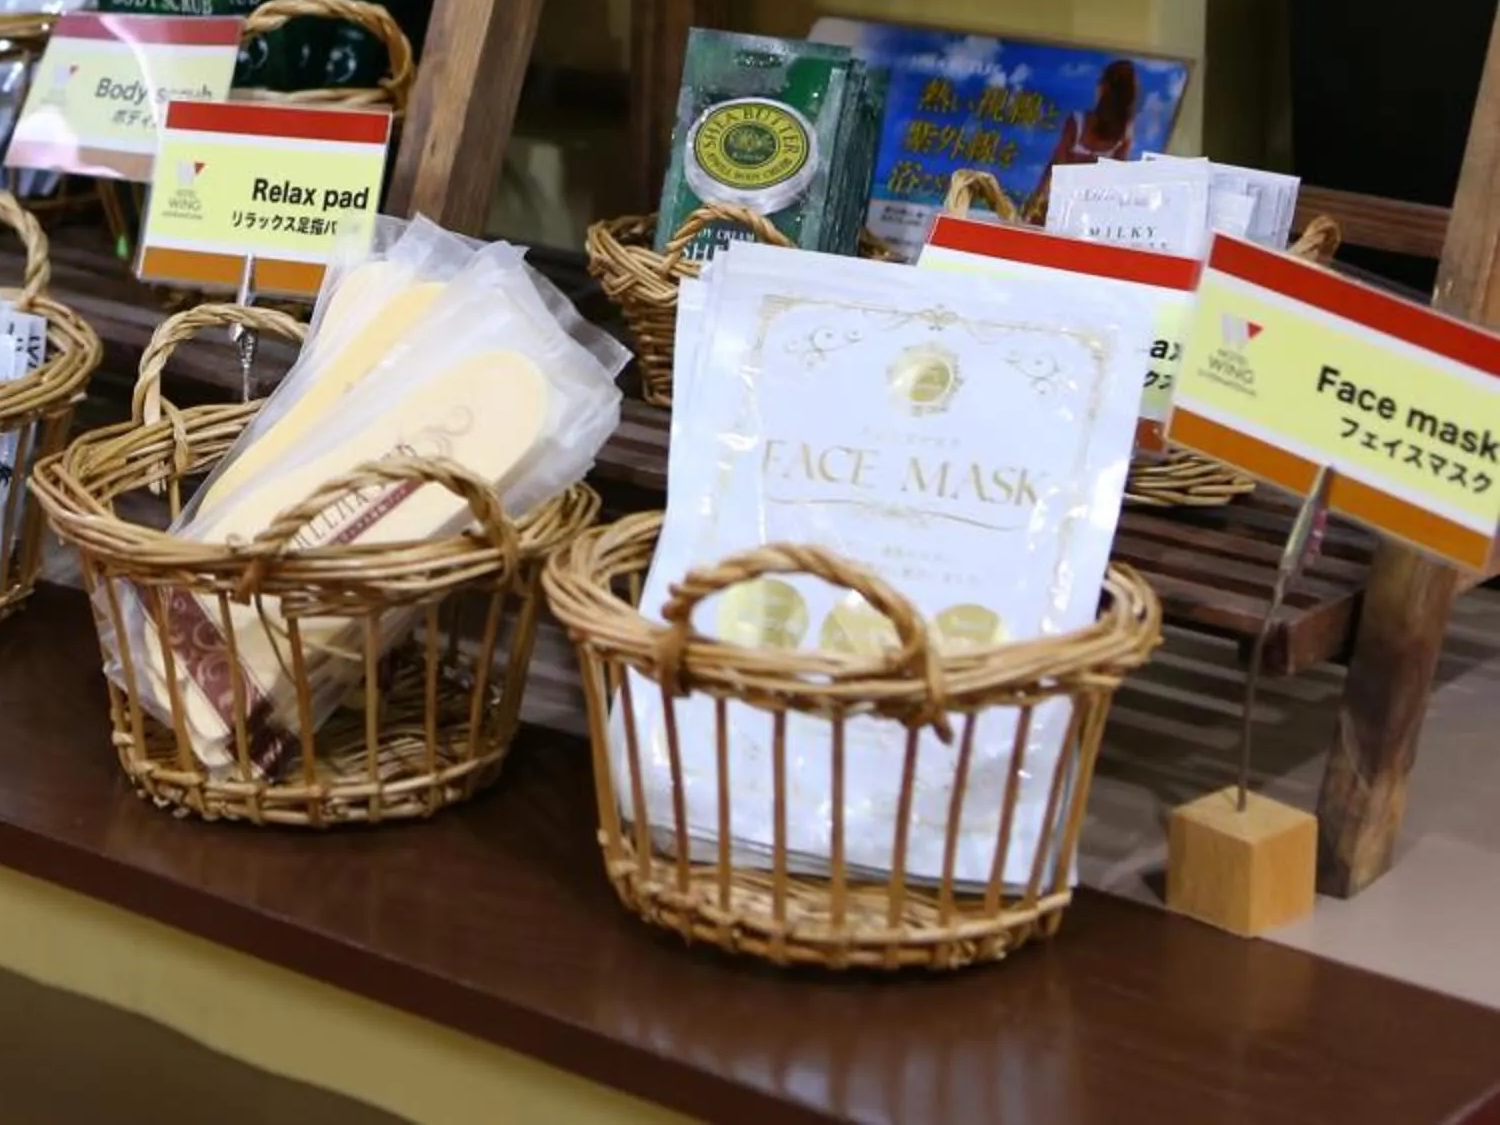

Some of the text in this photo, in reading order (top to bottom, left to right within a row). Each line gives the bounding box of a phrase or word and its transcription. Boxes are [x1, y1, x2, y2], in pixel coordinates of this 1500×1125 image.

[94, 77, 150, 106] Body
[251, 177, 370, 213] Relax pad
[1089, 223, 1158, 240] MILKY
[1208, 355, 1257, 385] WING
[1316, 363, 1500, 463] Face mask
[763, 438, 1050, 507] FACE MASK
[1340, 415, 1493, 494] フェイスマスク
